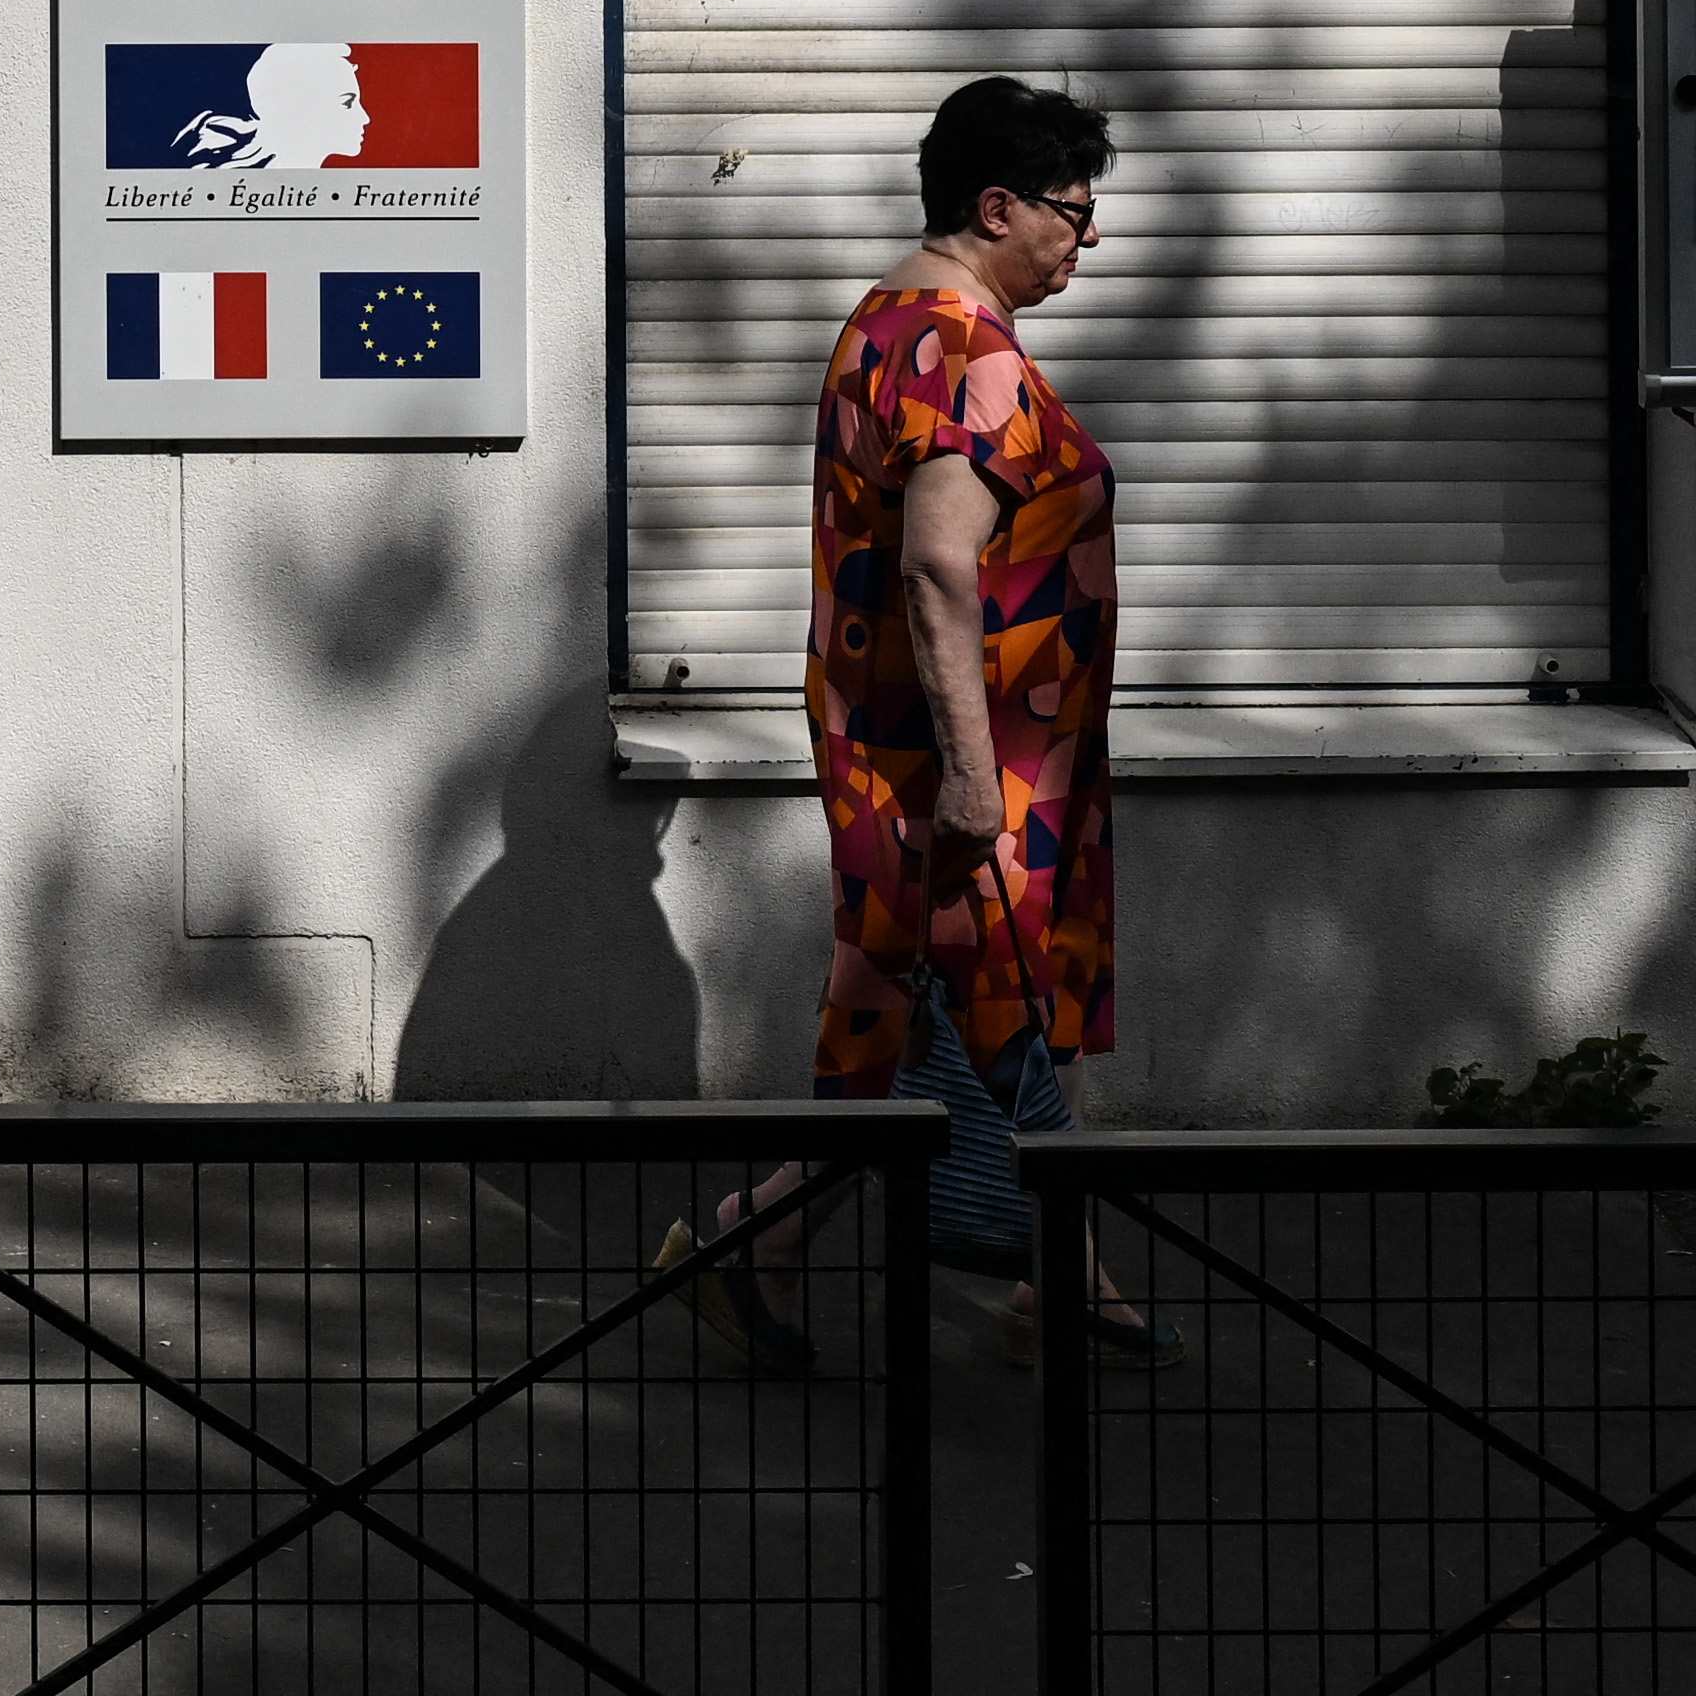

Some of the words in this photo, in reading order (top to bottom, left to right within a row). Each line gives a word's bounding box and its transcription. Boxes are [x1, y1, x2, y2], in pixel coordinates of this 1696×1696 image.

[105, 186, 193, 207] Liberté
[229, 179, 317, 213] Égalité
[354, 185, 480, 206] Fraternité
